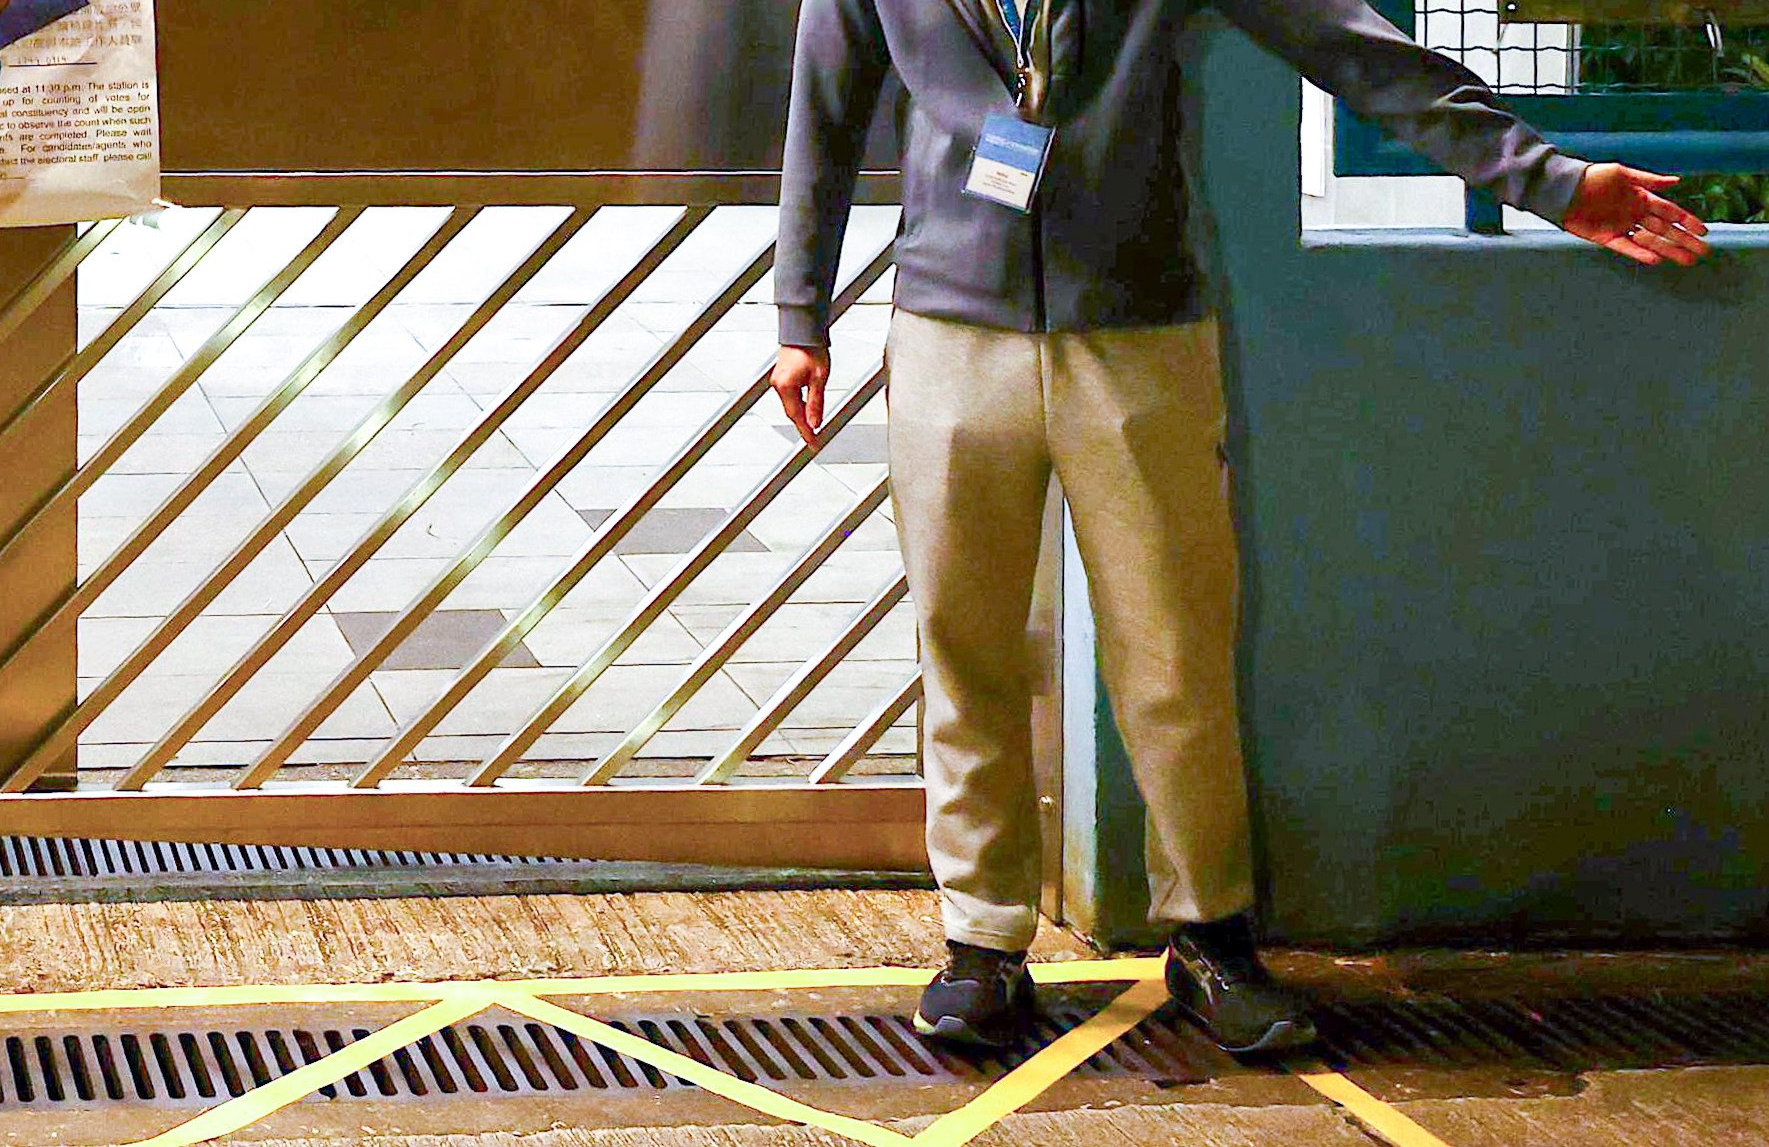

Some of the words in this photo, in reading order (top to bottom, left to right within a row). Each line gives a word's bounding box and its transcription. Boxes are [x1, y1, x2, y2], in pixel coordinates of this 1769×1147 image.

[108, 81, 139, 90] station
[41, 95, 81, 105] counting
[105, 94, 131, 102] votes
